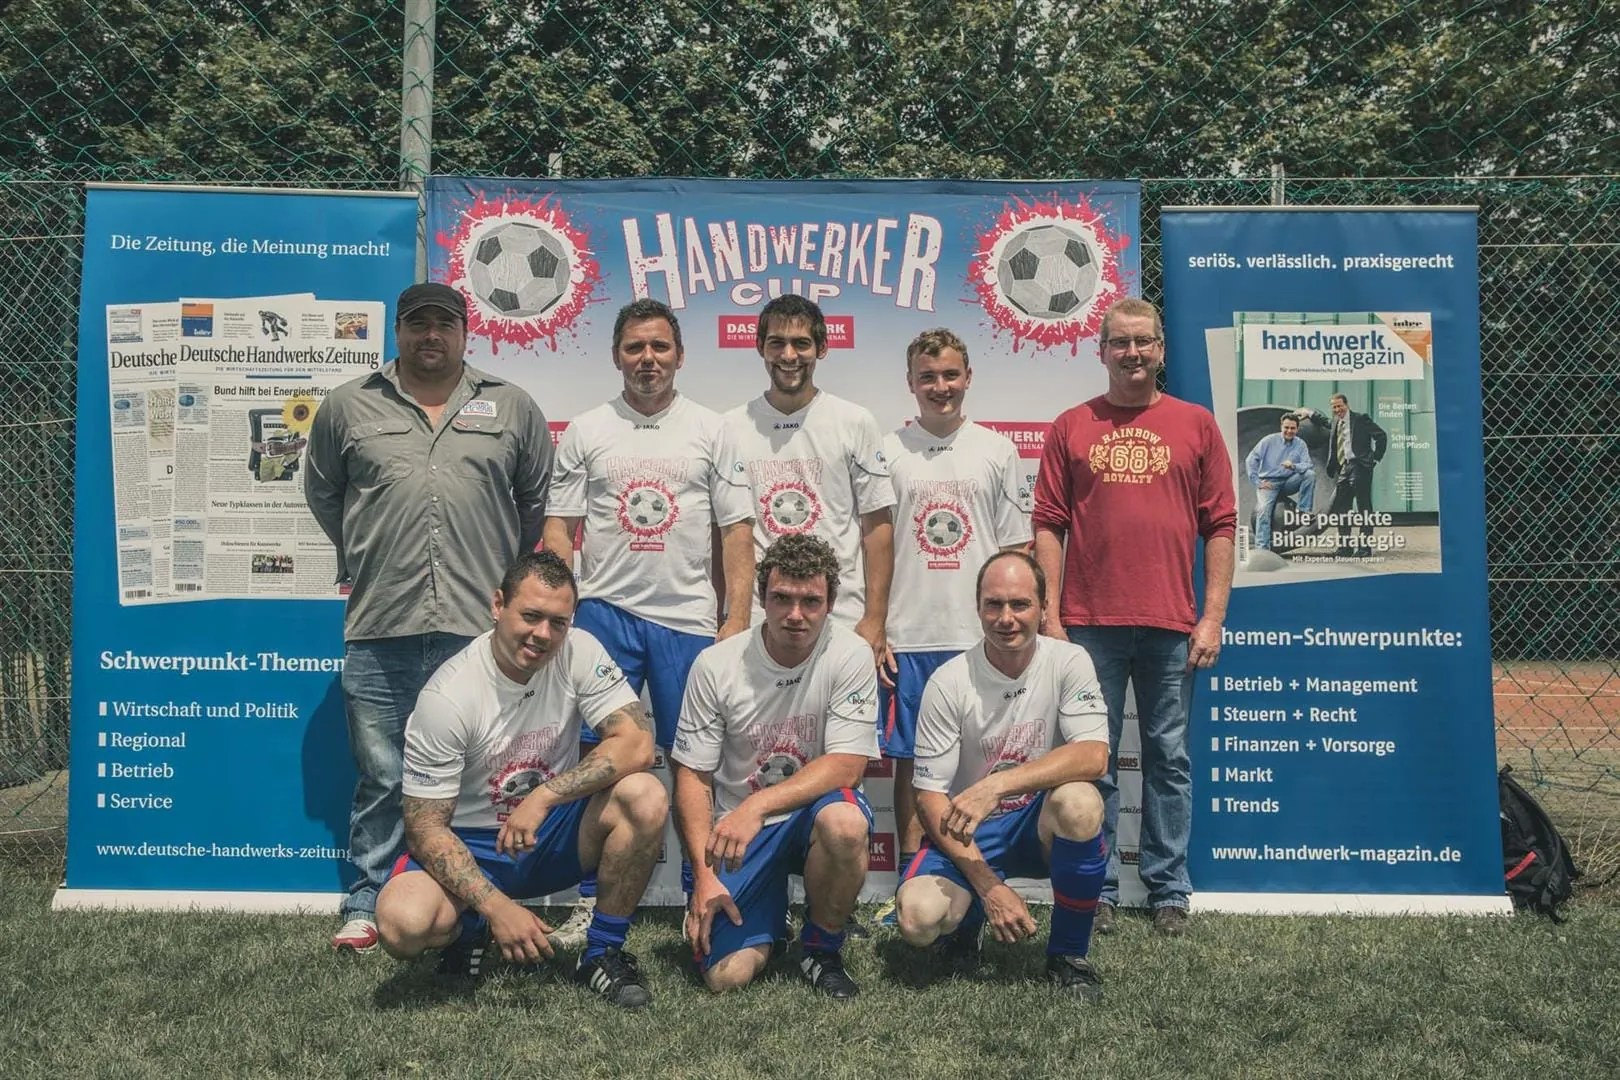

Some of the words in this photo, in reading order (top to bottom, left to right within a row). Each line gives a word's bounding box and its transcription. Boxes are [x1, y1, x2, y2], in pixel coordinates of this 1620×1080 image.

[111, 235, 141, 250] Die
[145, 235, 216, 256] Zeitung,
[221, 238, 247, 254] die
[252, 239, 328, 258] Meinung
[332, 242, 390, 257] macht!
[622, 213, 942, 312] HANDWERKER
[1189, 253, 1241, 268] seriös.
[1246, 253, 1337, 269] verlässlich.
[1344, 254, 1454, 272] praxisgerecht
[731, 279, 841, 306] CUP
[727, 324, 756, 334] DAS
[1262, 330, 1384, 350] handwerk
[111, 349, 177, 368] Deutsche
[180, 345, 245, 363] Deutsche
[246, 346, 324, 363] Handwerks
[326, 347, 378, 369] Zeitung
[1323, 347, 1404, 369] magazin
[214, 386, 236, 395] Bund
[239, 386, 255, 396] hilft
[258, 387, 271, 396] bei
[1102, 428, 1161, 444] RAINBOW
[1110, 445, 1148, 473] 68
[1103, 473, 1153, 483] ROYALTY
[1284, 510, 1310, 526] Die
[1317, 509, 1392, 529] perfekte
[1272, 530, 1405, 551] Bilanzstrategie
[1221, 628, 1463, 650] hemen-Schwerpunkte:
[100, 651, 345, 675] Schwerpunkt-Themen
[1224, 677, 1283, 692] Betrieb
[1289, 680, 1300, 690] +
[1306, 677, 1418, 695] Management
[112, 702, 201, 718] Wirtschaft
[206, 703, 240, 718] und
[244, 703, 298, 719] Politik
[1224, 707, 1286, 721] Steuern
[1293, 710, 1303, 720] +
[1310, 707, 1357, 722] Recht
[111, 732, 186, 752] Regional
[1224, 737, 1299, 752] Finanzen
[1306, 740, 1316, 750] +
[1322, 737, 1396, 756] Vorsorge
[111, 763, 174, 778] Betrieb
[1225, 767, 1273, 782] Markt
[111, 793, 173, 809] Service
[1224, 798, 1280, 813] Trends
[1212, 845, 1461, 864] www.handwerk-magazin.de
